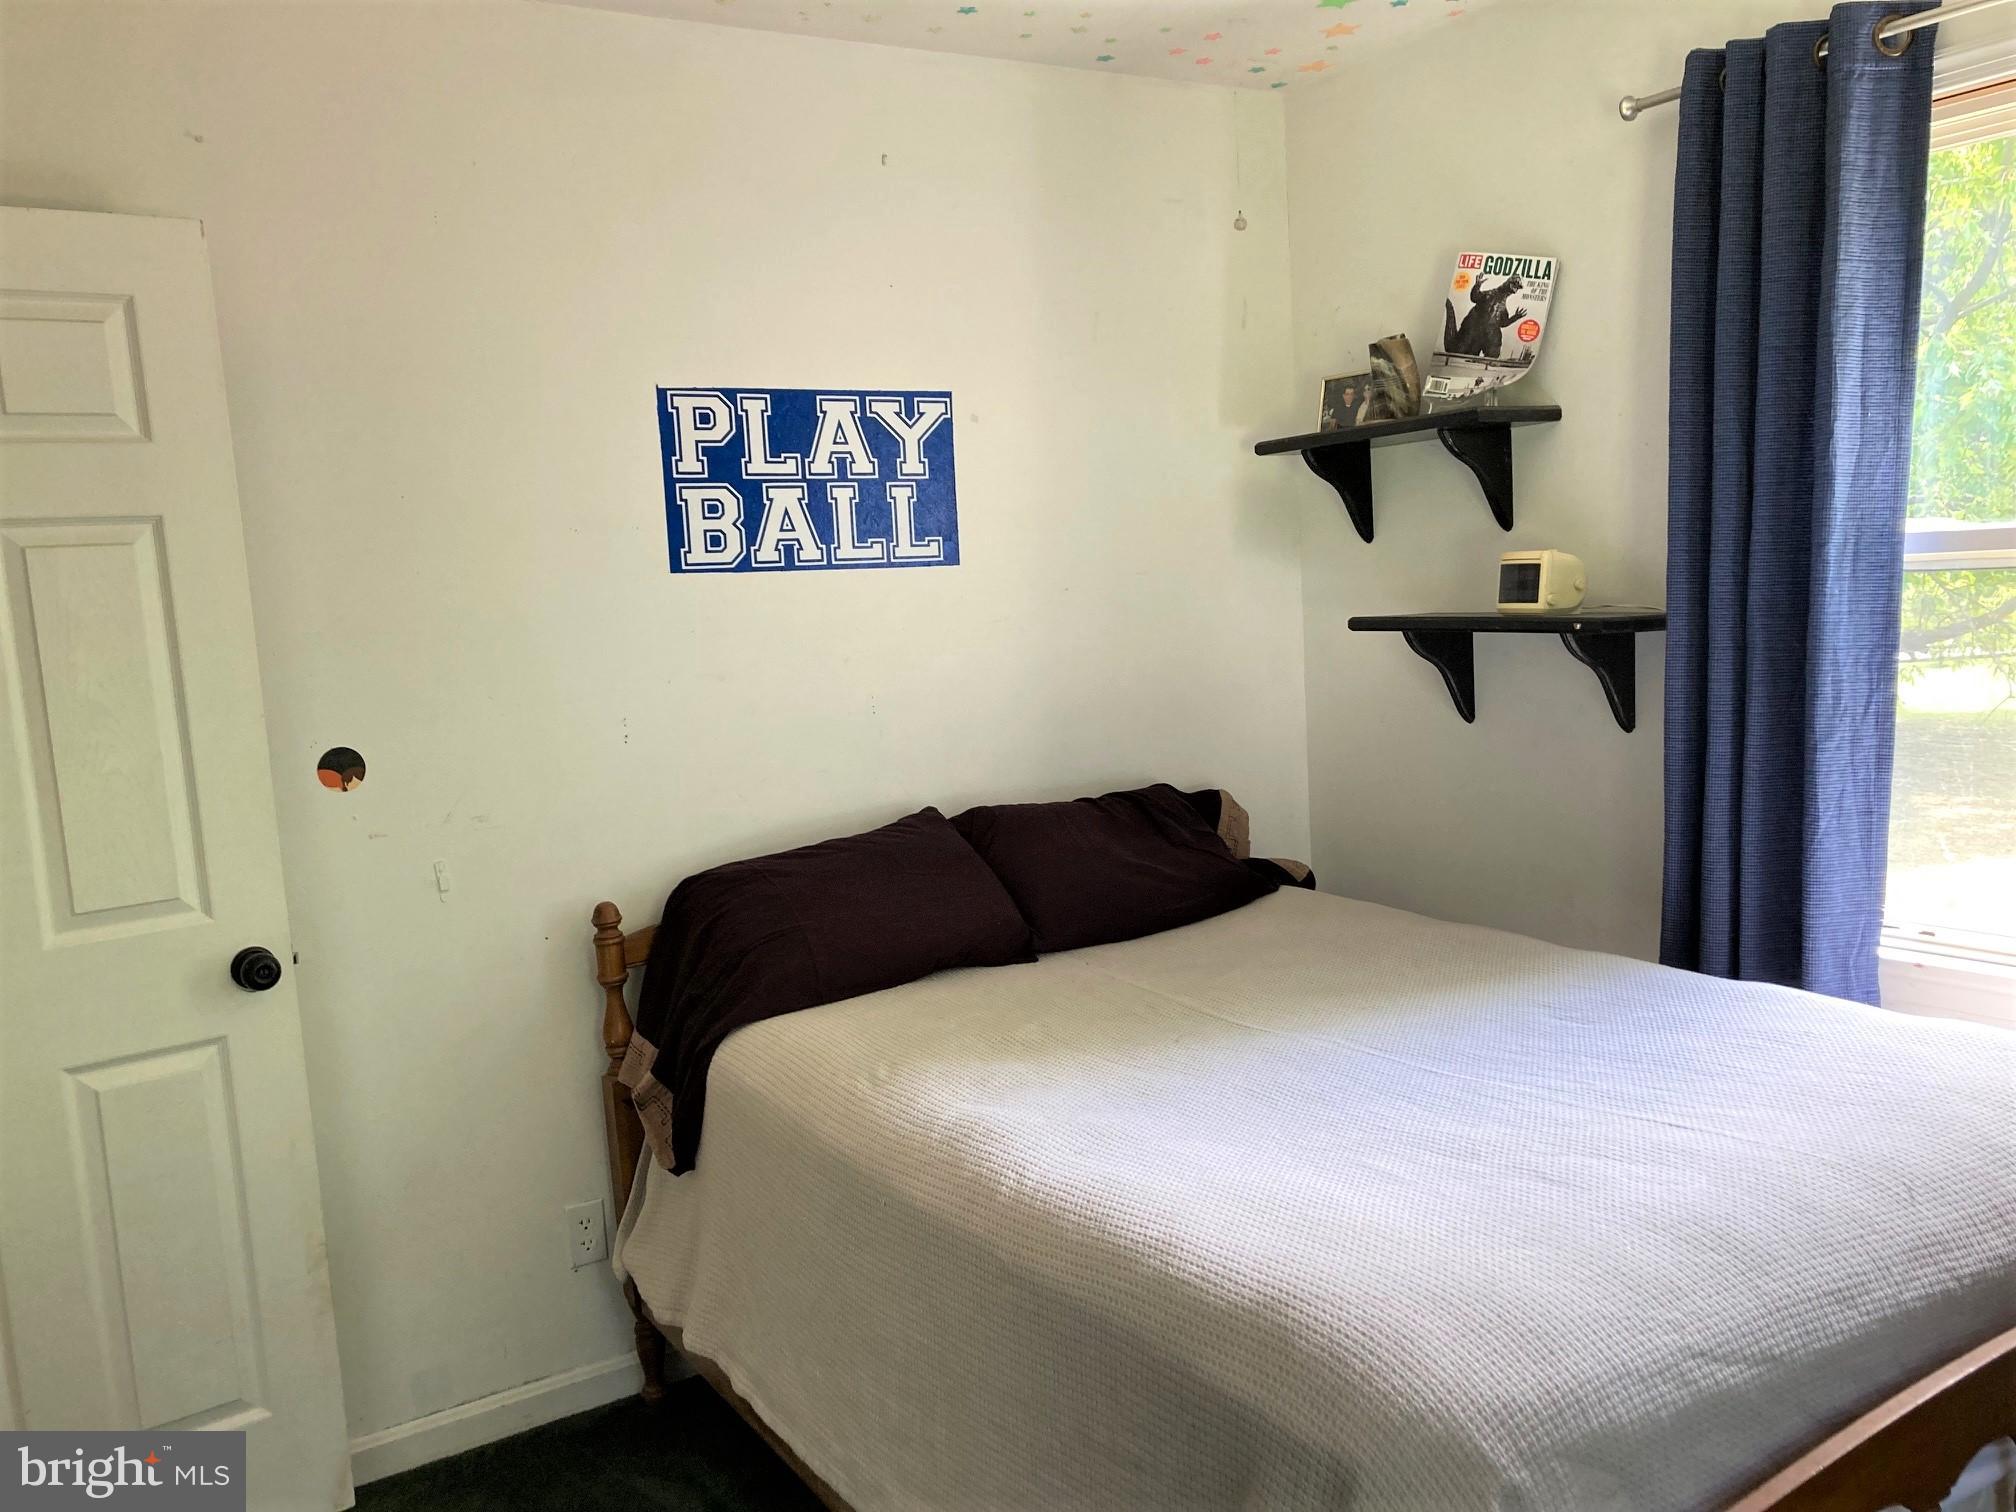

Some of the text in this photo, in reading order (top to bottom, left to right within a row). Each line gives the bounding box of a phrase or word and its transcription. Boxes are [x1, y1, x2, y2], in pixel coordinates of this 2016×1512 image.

[1459, 254, 1552, 281] LIFE GODZILLA
[666, 389, 951, 479] PLAY
[675, 481, 944, 570] BALL
